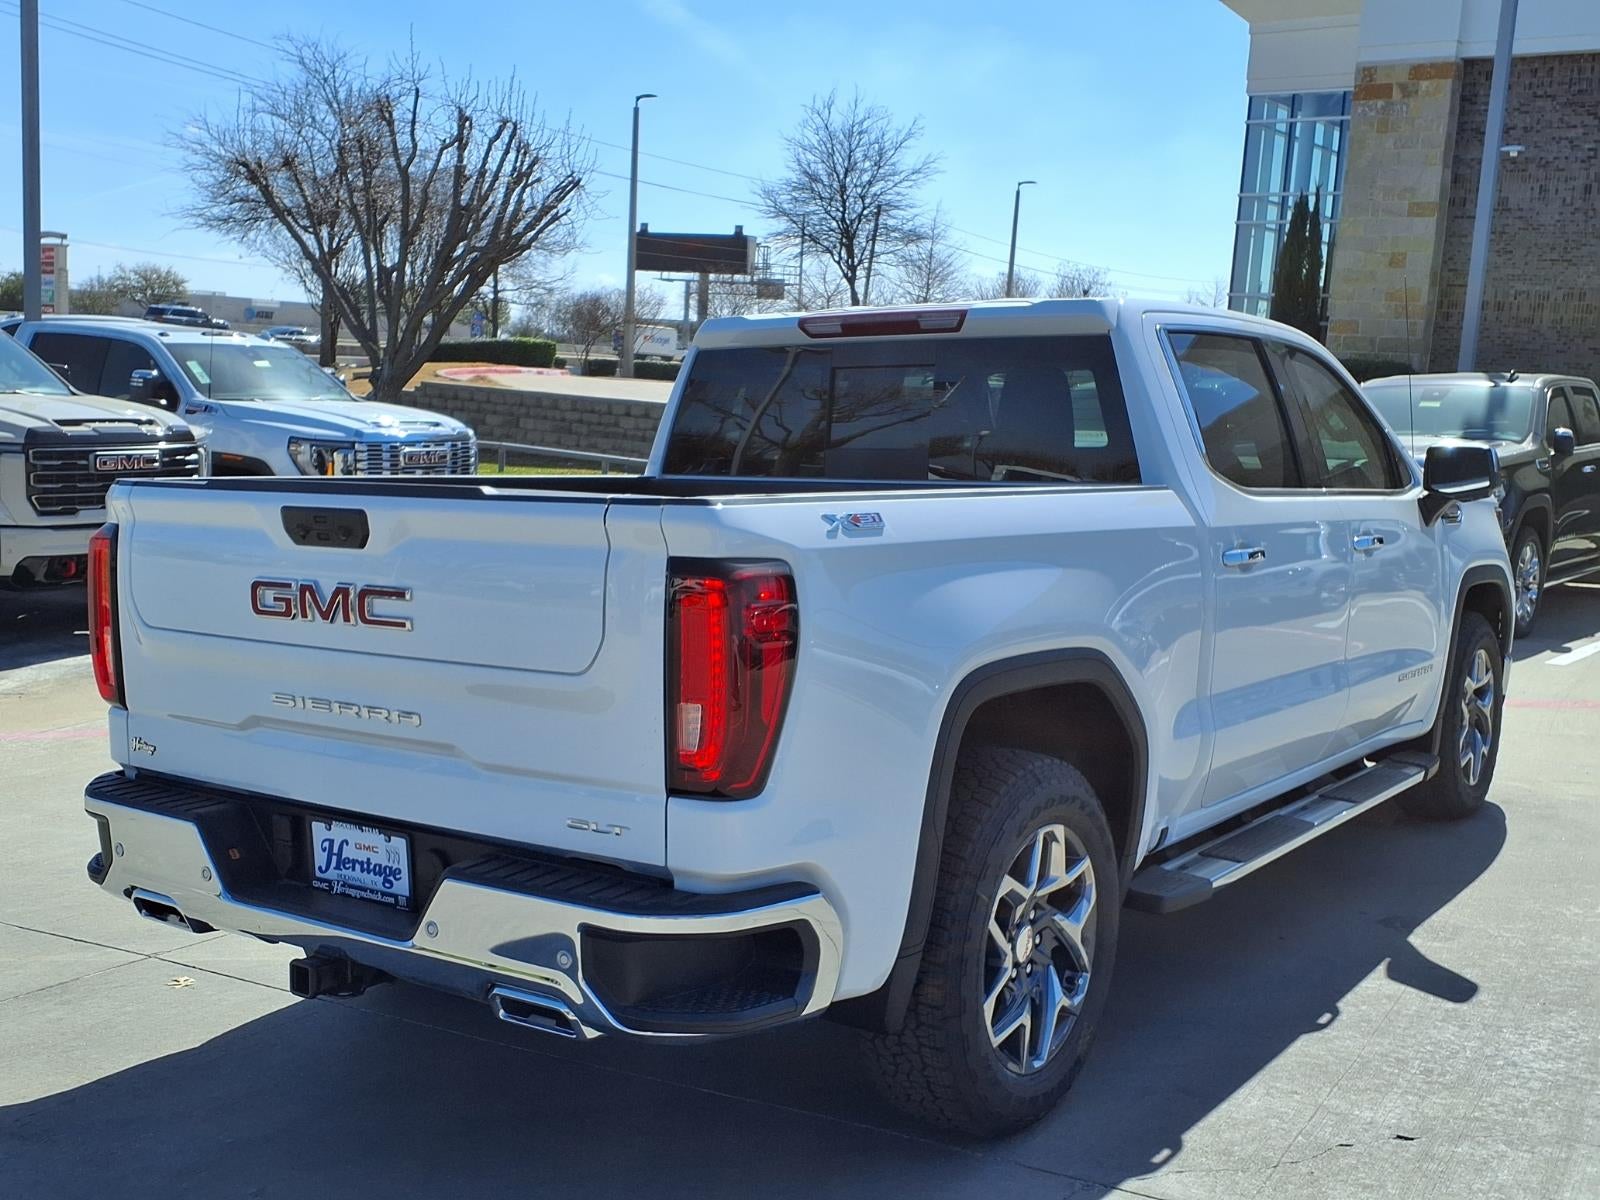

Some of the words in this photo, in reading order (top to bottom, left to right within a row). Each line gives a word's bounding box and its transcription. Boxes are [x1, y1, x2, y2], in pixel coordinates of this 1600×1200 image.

[96, 455, 160, 470] GMC
[405, 451, 449, 465] GMC
[250, 577, 414, 632] GMC
[271, 692, 422, 728] SIERRA
[567, 817, 631, 837] SLT
[354, 842, 379, 854] GMC
[318, 838, 402, 890] Heritage
[312, 880, 329, 890] GMC
